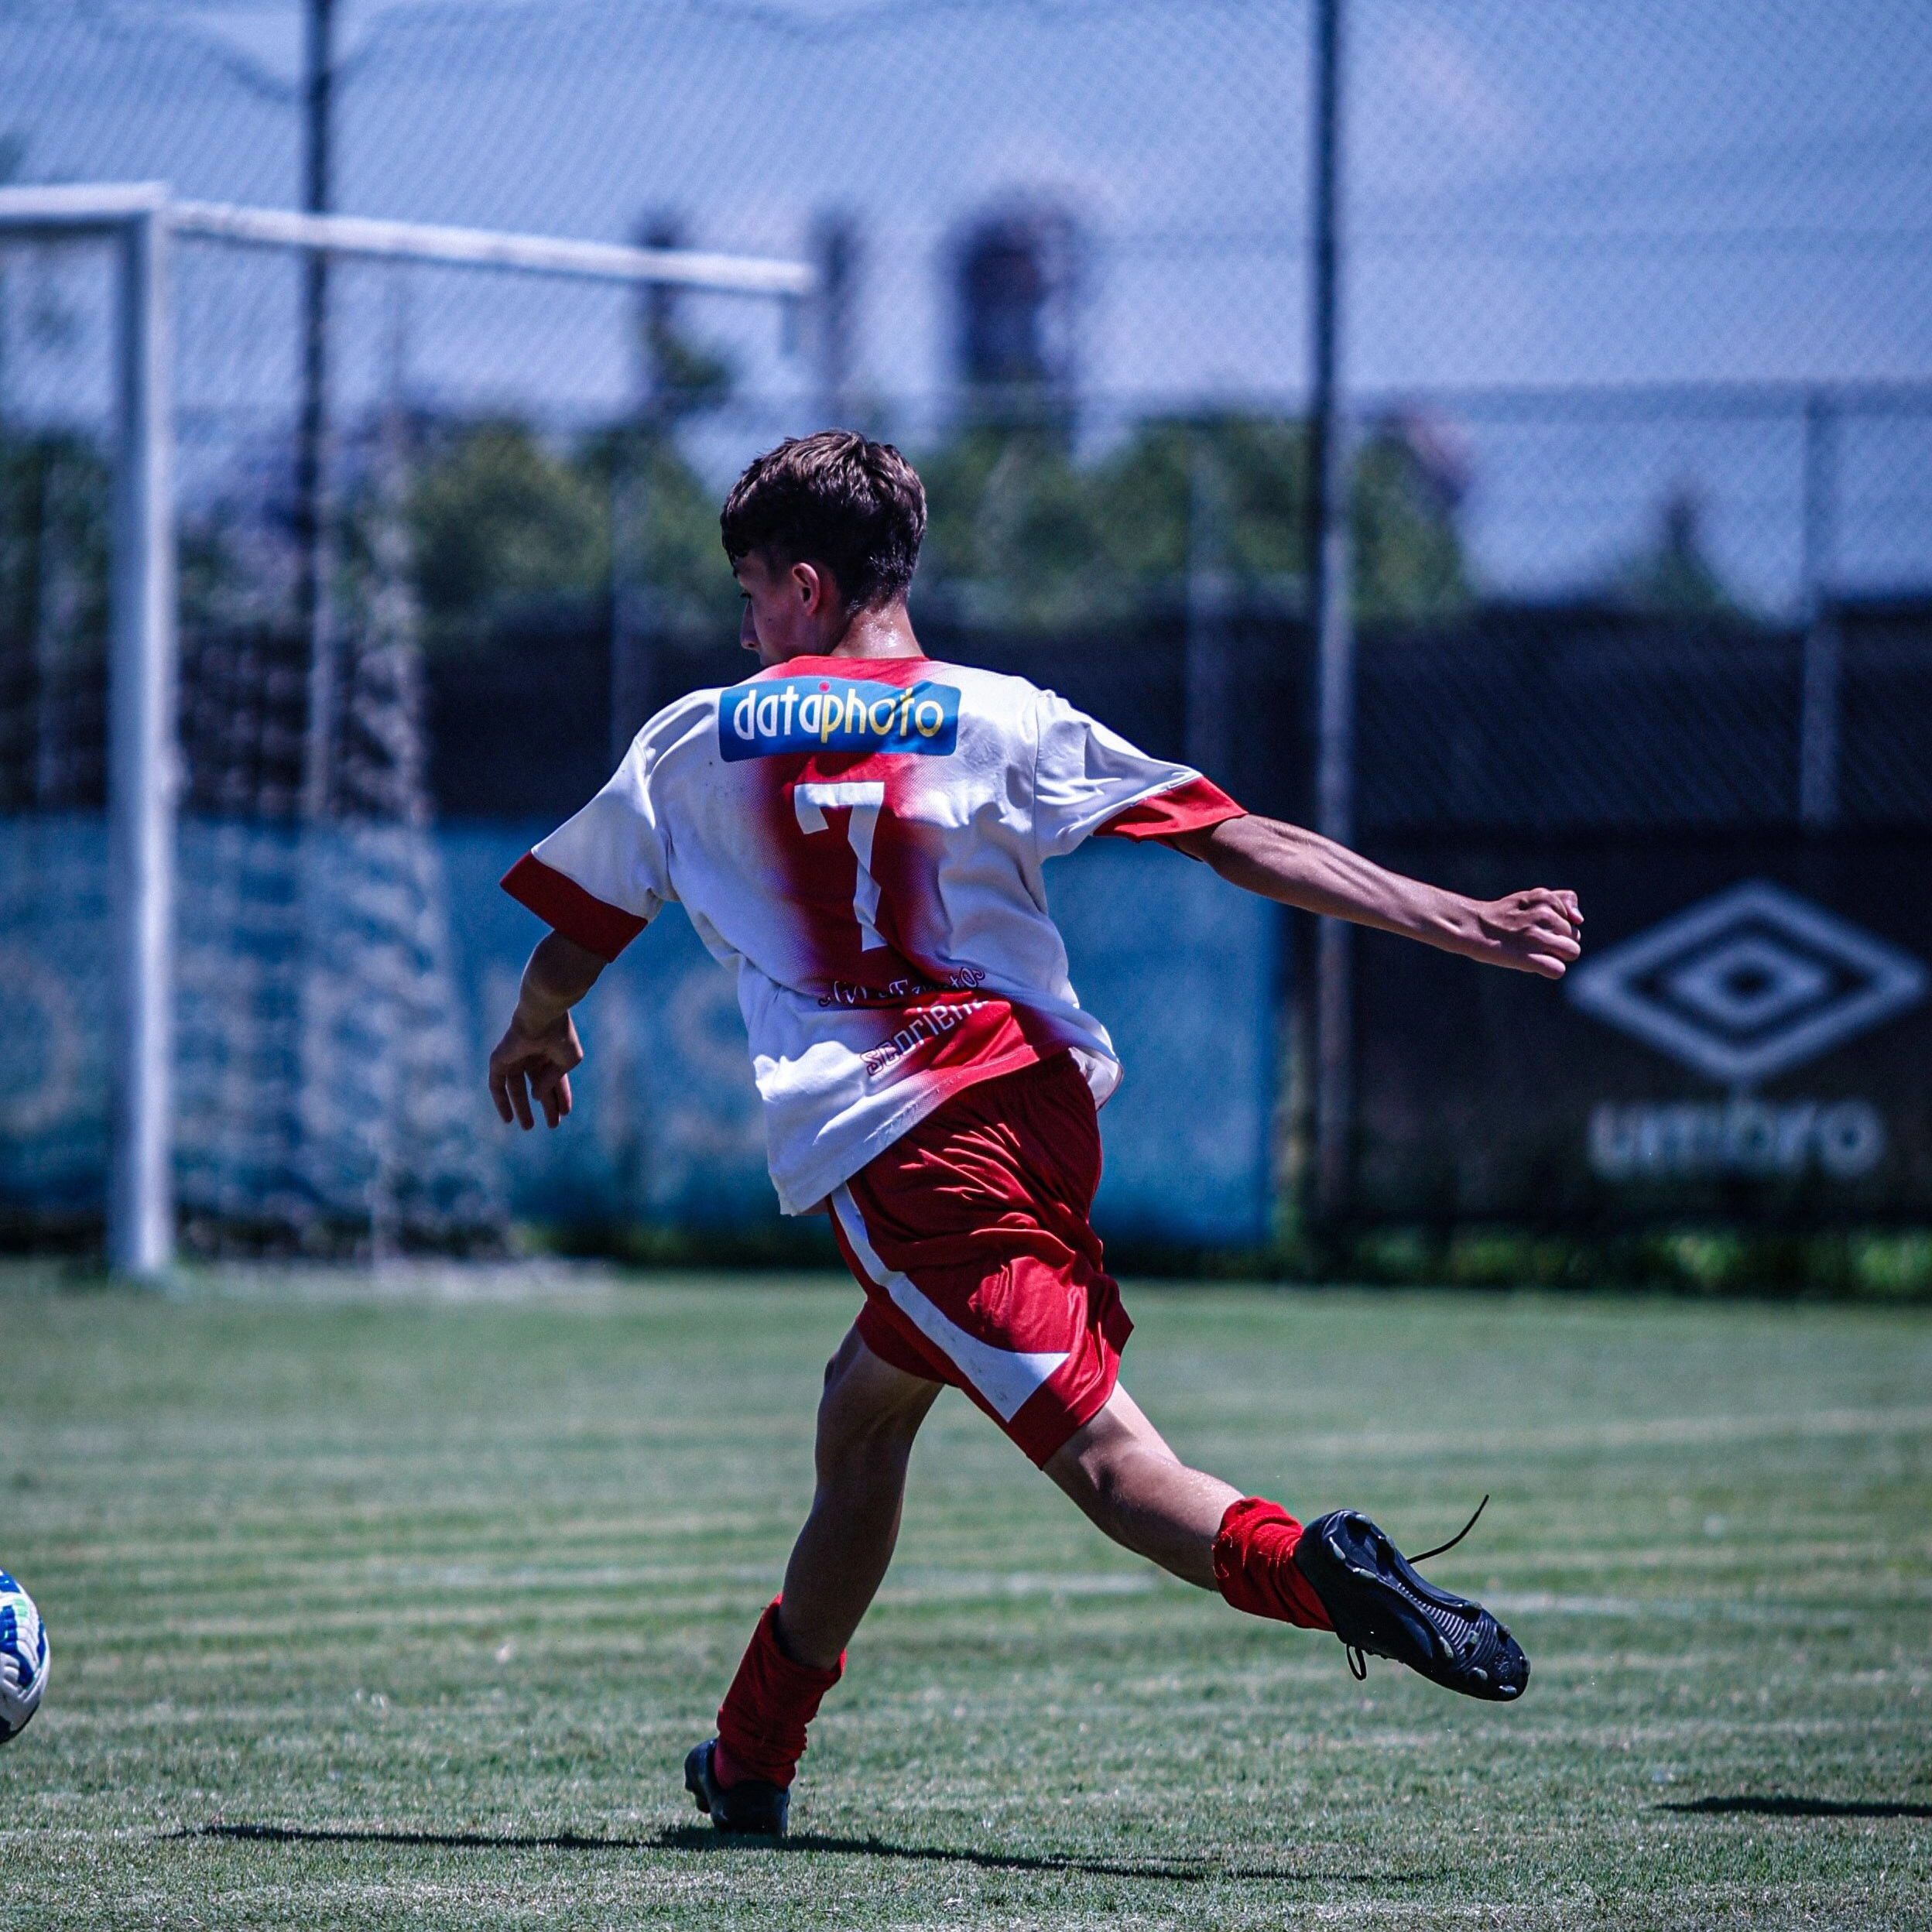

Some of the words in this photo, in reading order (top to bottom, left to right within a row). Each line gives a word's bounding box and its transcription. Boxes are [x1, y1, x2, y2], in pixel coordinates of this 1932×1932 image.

[734, 682, 944, 743] dataphoto
[794, 781, 888, 952] 7
[1590, 1088, 1883, 1178] umbro
